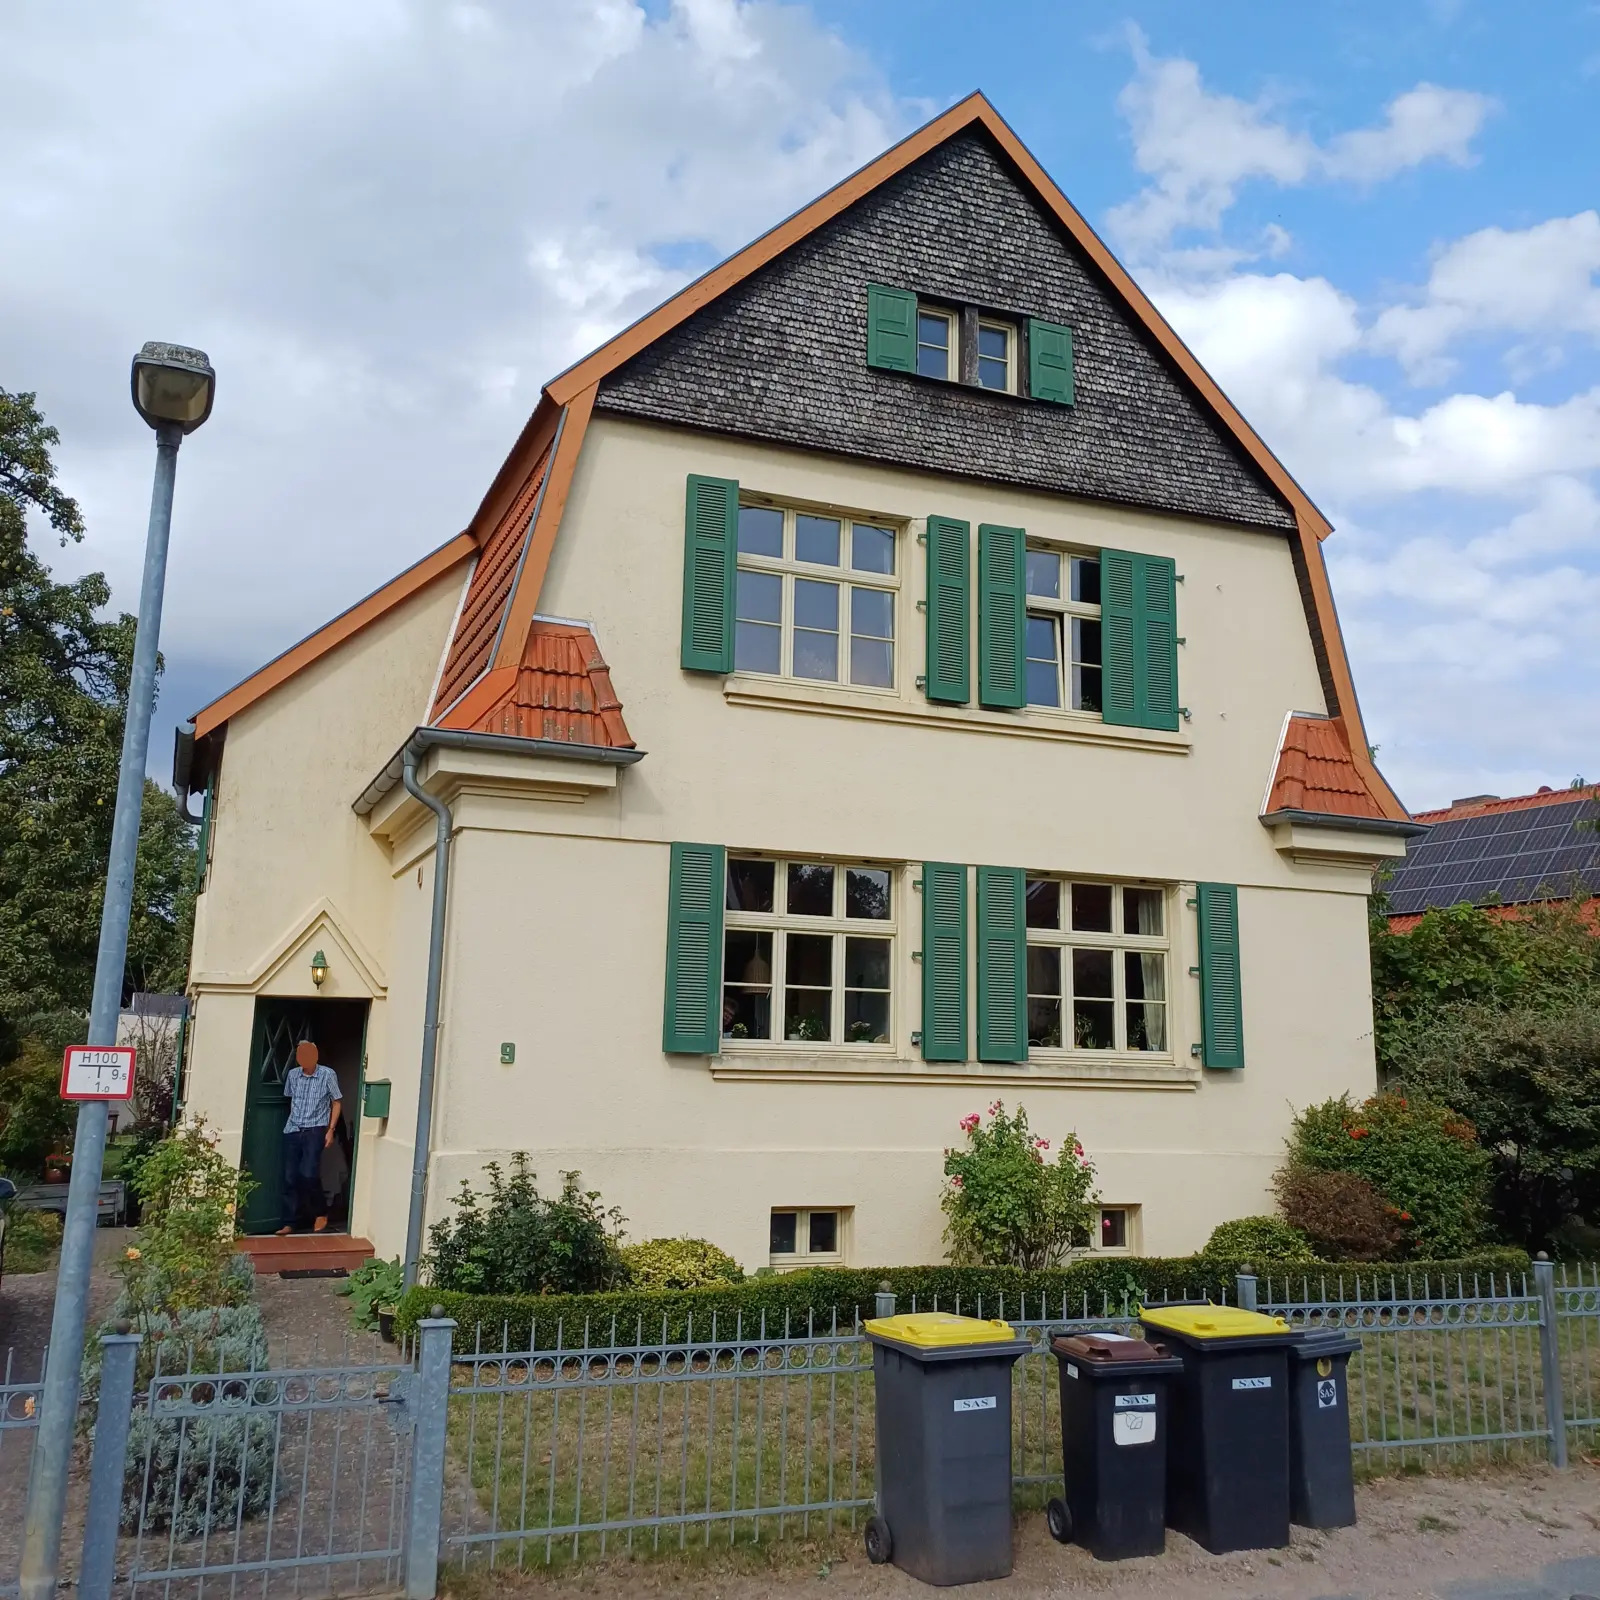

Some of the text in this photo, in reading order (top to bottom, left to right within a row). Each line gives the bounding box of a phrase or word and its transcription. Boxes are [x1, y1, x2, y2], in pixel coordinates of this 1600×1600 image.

[501, 1043, 515, 1064] 9
[1238, 1379, 1265, 1387] SAS
[1320, 1388, 1334, 1399] SAS
[962, 1399, 989, 1409] SAS
[1122, 1395, 1149, 1405] SAS
